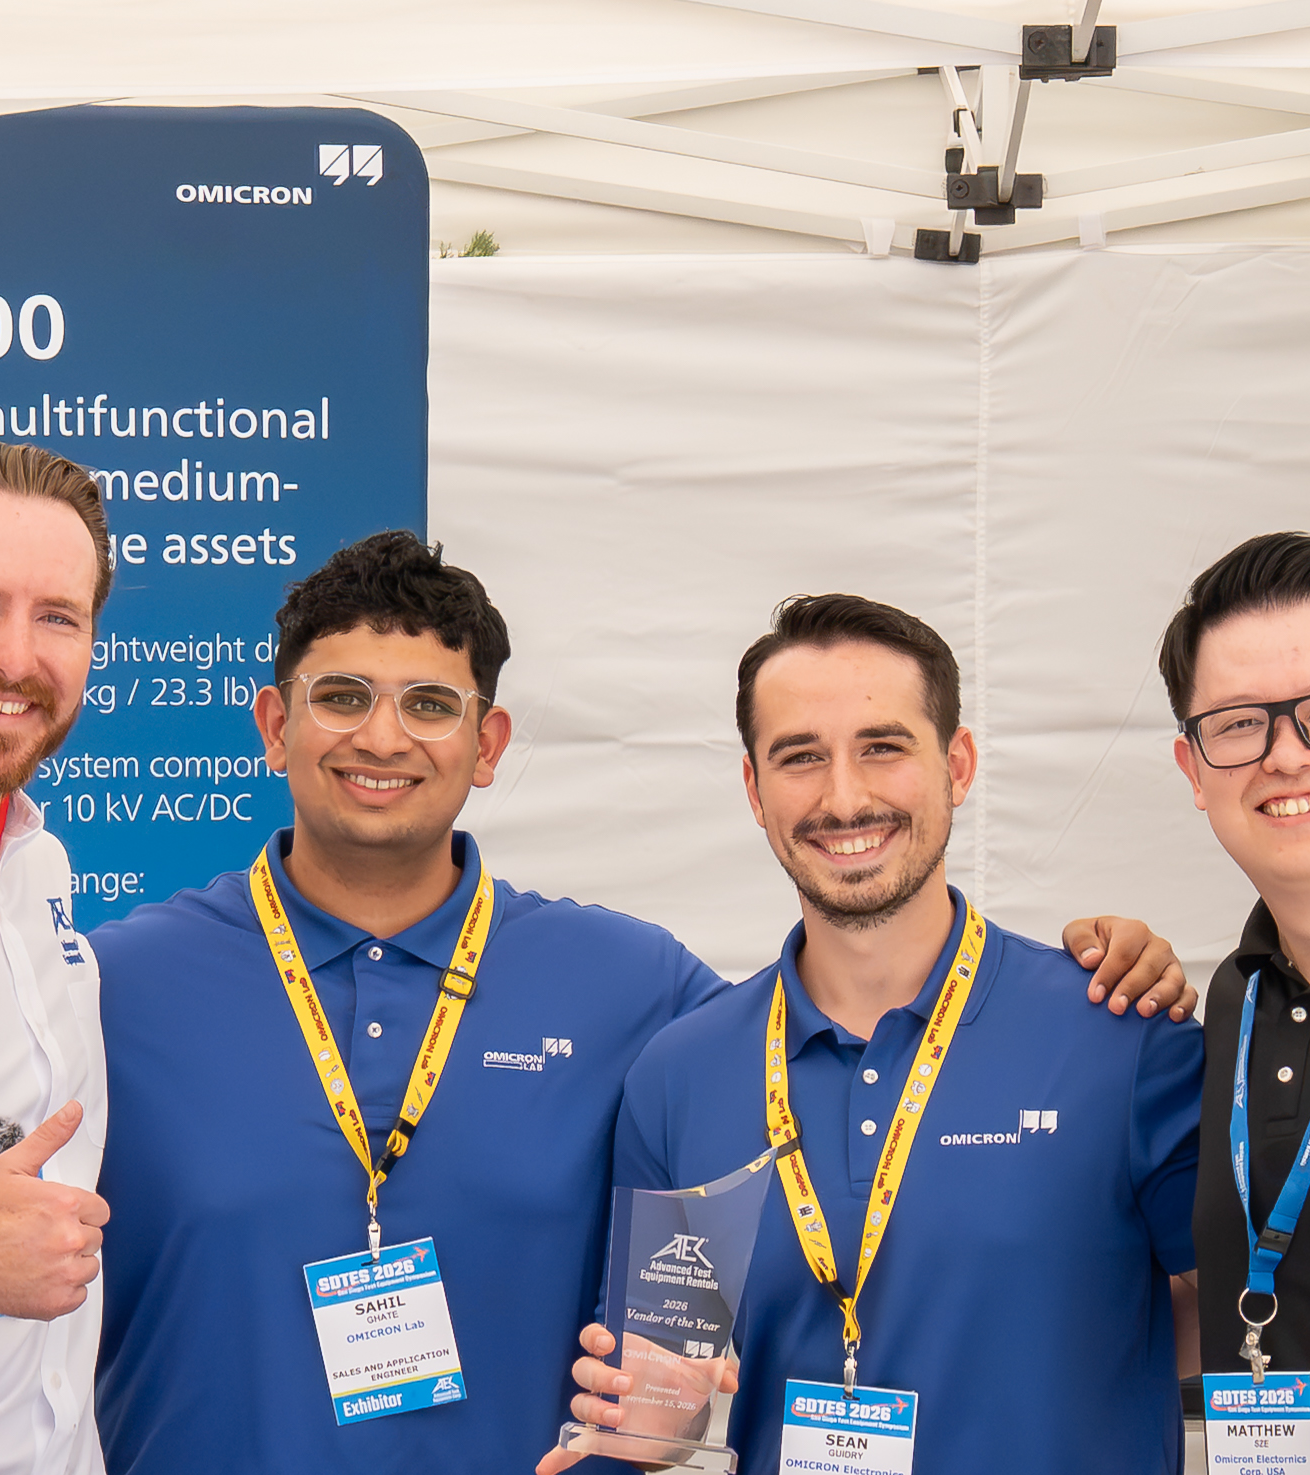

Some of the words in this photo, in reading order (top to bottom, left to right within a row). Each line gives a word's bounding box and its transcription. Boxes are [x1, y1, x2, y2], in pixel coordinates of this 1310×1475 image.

[175, 183, 313, 205] OMICRON
[97, 458, 299, 501] medium-
[162, 527, 297, 565] assets
[83, 677, 116, 715] kg
[127, 680, 138, 708] /
[150, 679, 212, 707] 23.3
[223, 677, 258, 711] lb)
[38, 755, 140, 785] system
[63, 795, 95, 822] 10
[106, 793, 142, 822] kV
[152, 794, 252, 822] AC/DC
[483, 1052, 542, 1064] OMICRON
[524, 1062, 543, 1071] LAB
[940, 1133, 1017, 1145] OMICRON
[317, 1272, 371, 1292] SDTES
[373, 1260, 415, 1281] 2026
[650, 1260, 691, 1276] Advanced
[692, 1266, 712, 1278] Test
[640, 1270, 685, 1286] Equipment
[686, 1276, 718, 1290] Rentals
[355, 1296, 406, 1316] SAHIL
[663, 1299, 688, 1311] 2026
[367, 1311, 399, 1324] GHATE
[627, 1308, 663, 1324] Vendor
[665, 1316, 676, 1327] of
[676, 1318, 694, 1328] the
[696, 1319, 720, 1332] Year
[347, 1325, 402, 1343] OMICRON
[405, 1320, 425, 1331] Lab
[333, 1367, 361, 1380] SALES
[364, 1363, 384, 1374] AND
[386, 1349, 450, 1368] APPLICATION
[371, 1365, 418, 1381] ENGINEER
[343, 1393, 403, 1417] Exhibitor
[1212, 1390, 1257, 1405] SDTES
[1260, 1390, 1294, 1405] 2026
[795, 1397, 846, 1416] SDTES
[849, 1403, 891, 1421] 2026
[1227, 1425, 1295, 1437] MATTHEW
[826, 1434, 868, 1449] SEAN
[829, 1449, 863, 1460] GUIDRY
[1215, 1455, 1253, 1464] Omicron
[786, 1459, 839, 1472] OMICRON
[1267, 1468, 1285, 1475] USA
